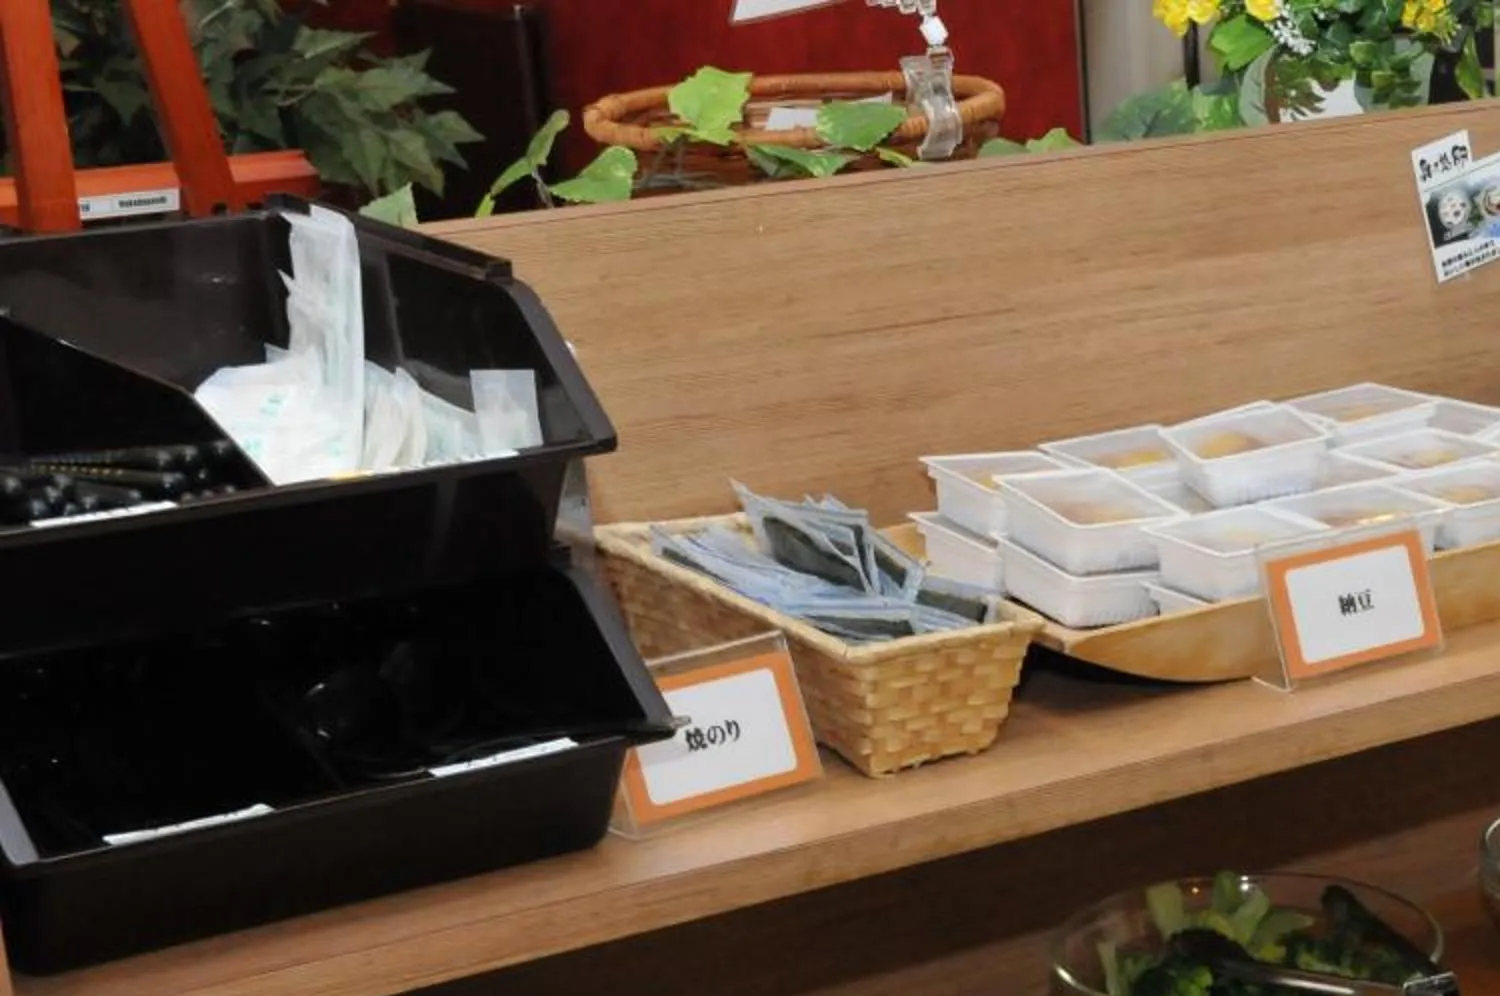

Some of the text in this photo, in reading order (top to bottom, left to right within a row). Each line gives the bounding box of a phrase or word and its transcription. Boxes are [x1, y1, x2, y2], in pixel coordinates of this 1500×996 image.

[1337, 588, 1374, 616] 納豆
[685, 719, 740, 752] 焼のり
